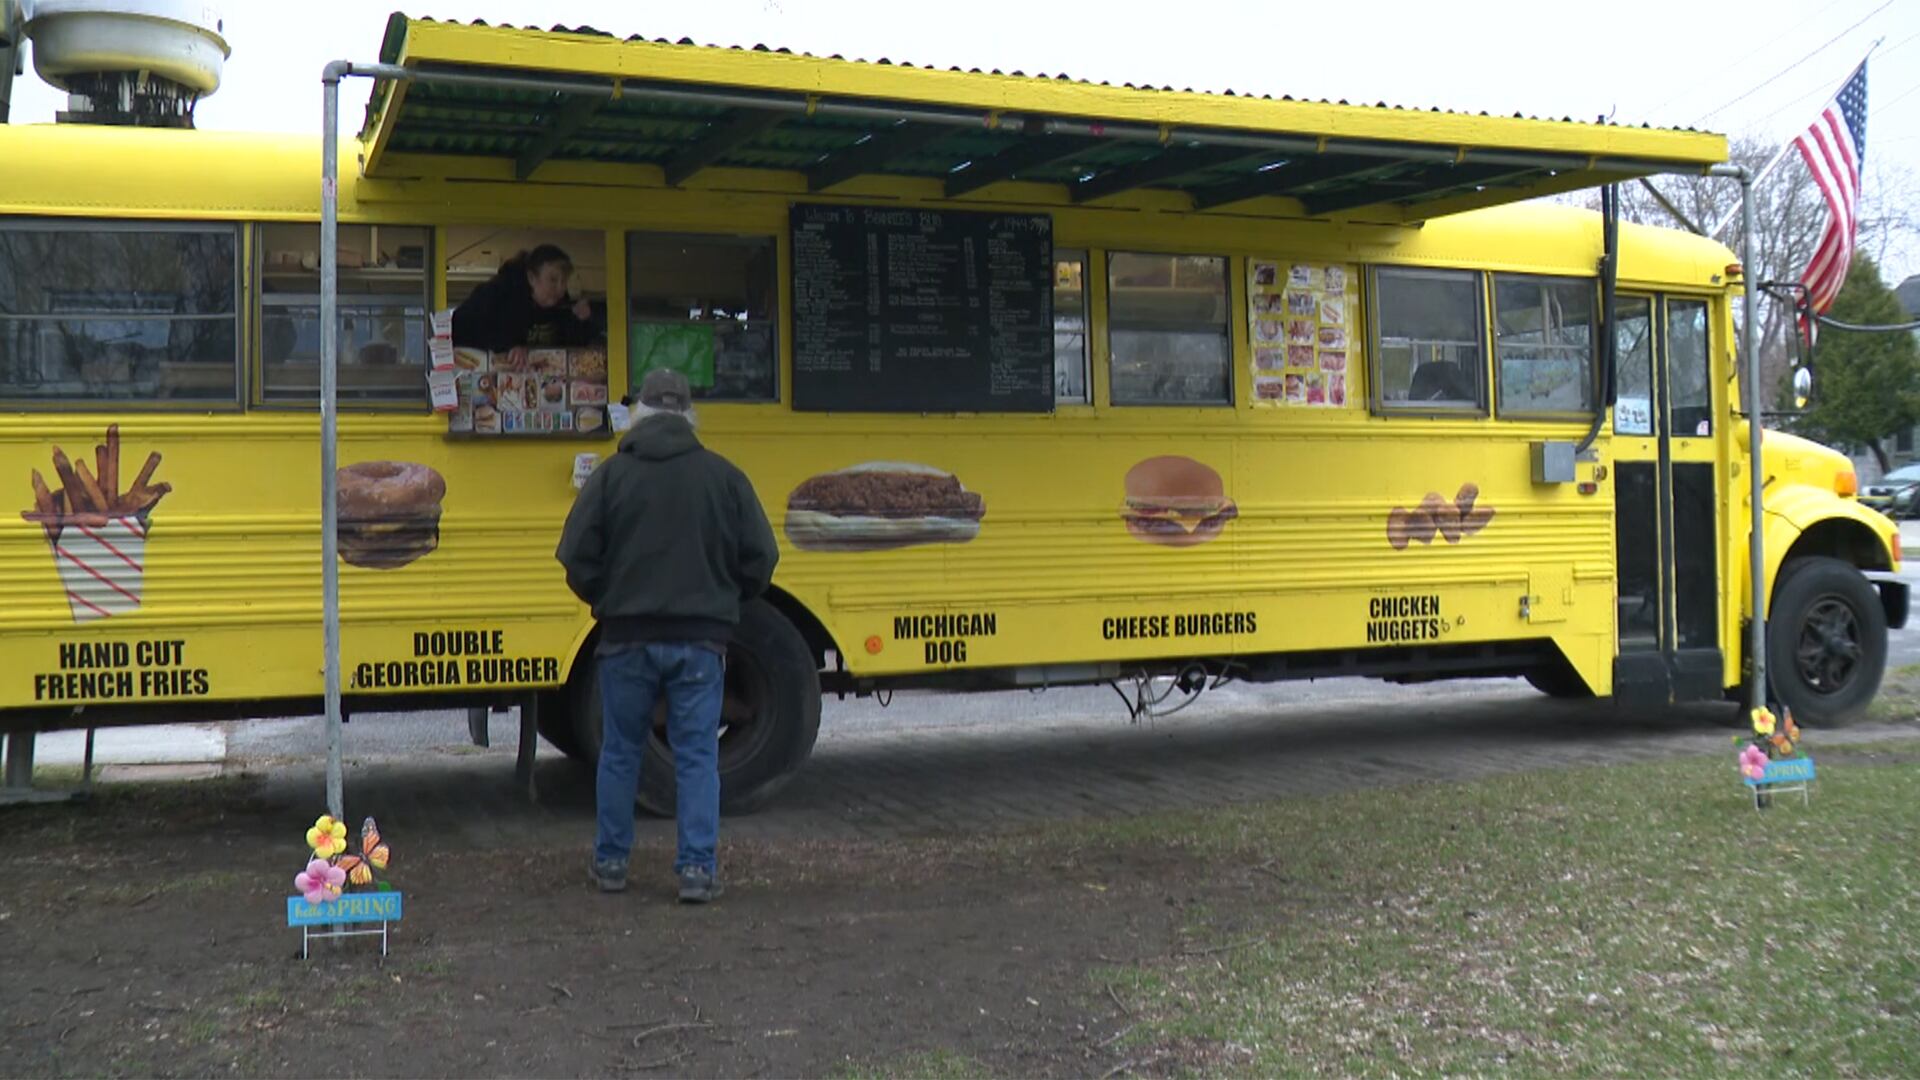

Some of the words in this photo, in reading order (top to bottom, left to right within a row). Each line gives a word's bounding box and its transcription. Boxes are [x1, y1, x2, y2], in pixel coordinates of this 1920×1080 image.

[1369, 596, 1440, 618] CHICKEN
[893, 613, 997, 640] MICHIGAN
[1102, 616, 1170, 640] CHEESE
[1174, 612, 1257, 637] BURGERS
[1367, 619, 1439, 641] NUGGETS
[59, 642, 130, 670] HAND
[136, 640, 186, 668] CUT
[413, 630, 504, 658] DOUBLE
[924, 640, 967, 665] DOG
[34, 671, 134, 701] FRENCH
[140, 669, 210, 697] FRIES
[356, 660, 461, 689] GEORGIA
[466, 657, 560, 685] BURGER
[328, 896, 397, 917] SPRING
